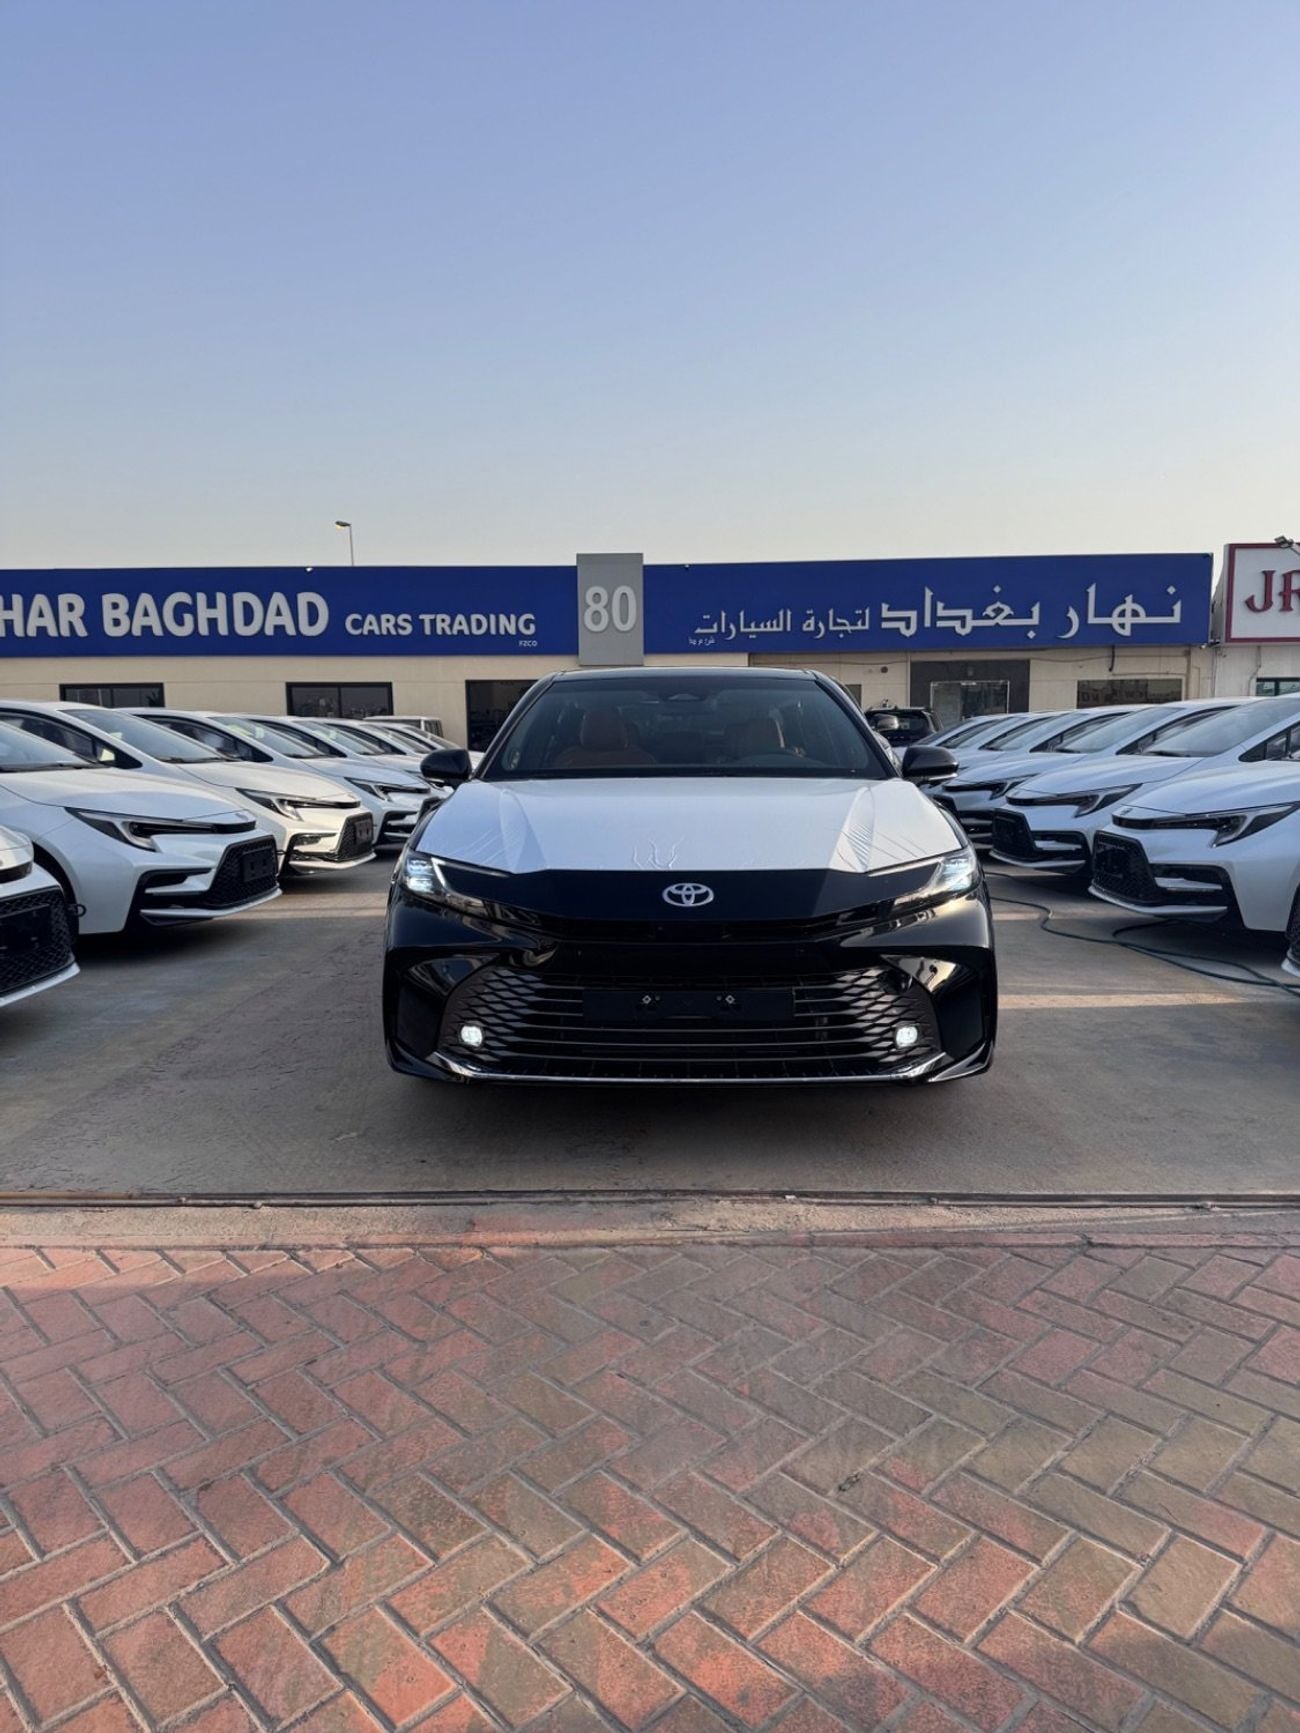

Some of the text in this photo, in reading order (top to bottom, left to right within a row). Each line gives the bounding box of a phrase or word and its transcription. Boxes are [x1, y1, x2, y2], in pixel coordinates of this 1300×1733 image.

[0, 592, 536, 638] HAR BAGHDAD CARS TRADING
[584, 585, 636, 632] 80
[694, 583, 1182, 640] نهار بغداد لتجارة السيارات
